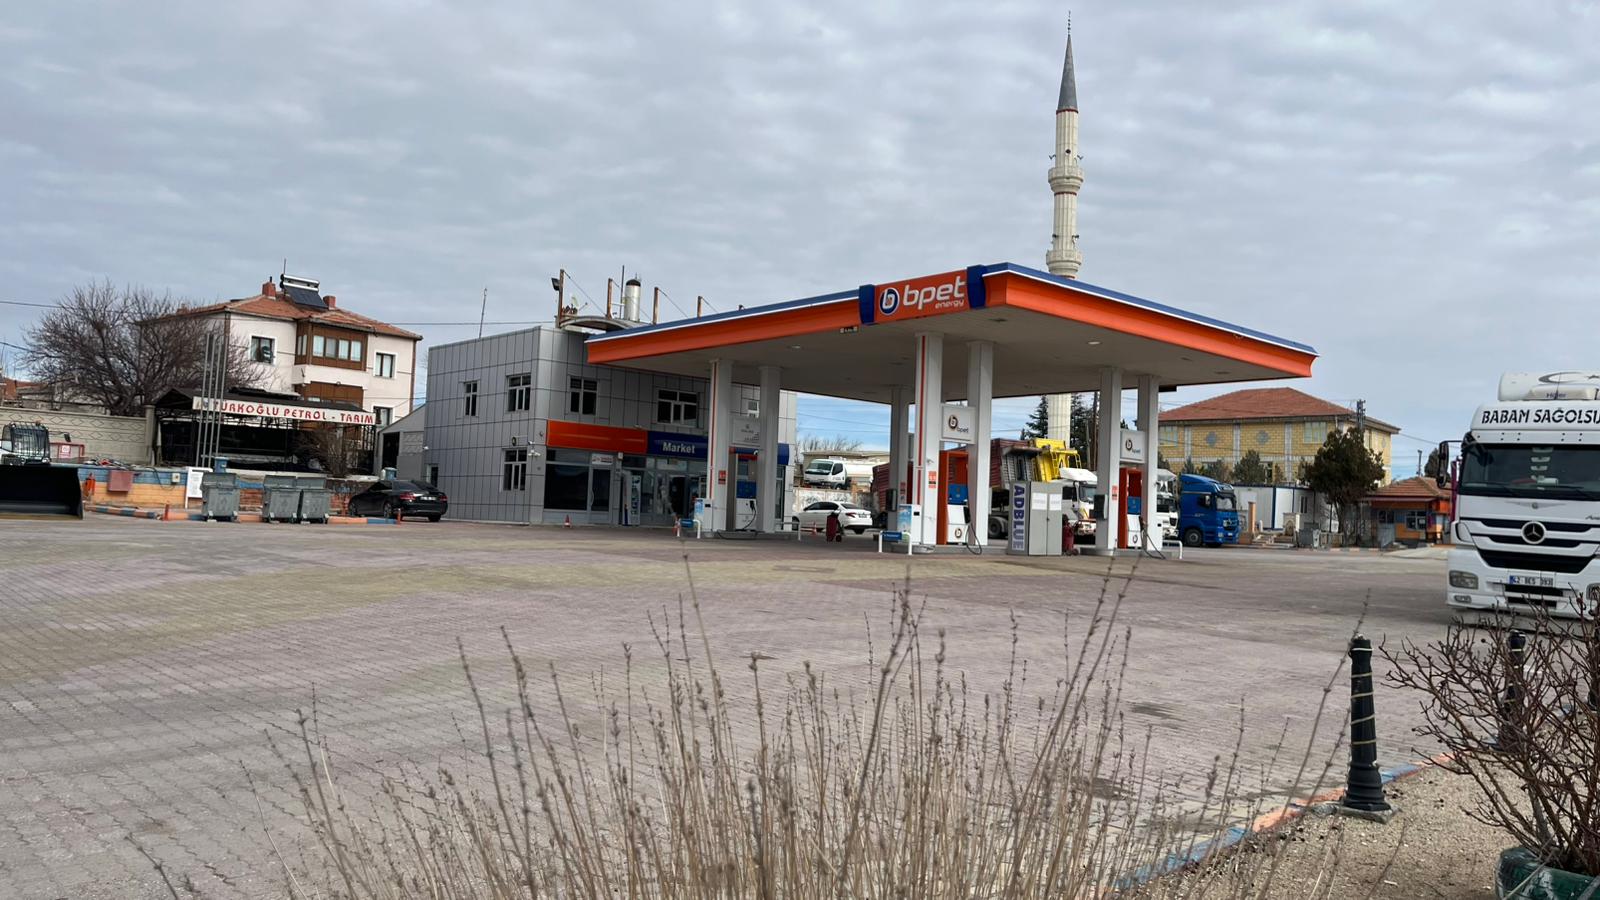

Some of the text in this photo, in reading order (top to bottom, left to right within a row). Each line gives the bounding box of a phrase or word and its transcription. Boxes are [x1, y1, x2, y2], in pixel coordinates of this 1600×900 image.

[903, 276, 965, 310] bpet
[935, 299, 964, 310] energy
[284, 408, 326, 420] PETROL
[340, 413, 373, 424] TARIM
[1481, 409, 1530, 424] BABAM
[662, 441, 695, 454] Market
[1013, 485, 1025, 549] ADBLUE
